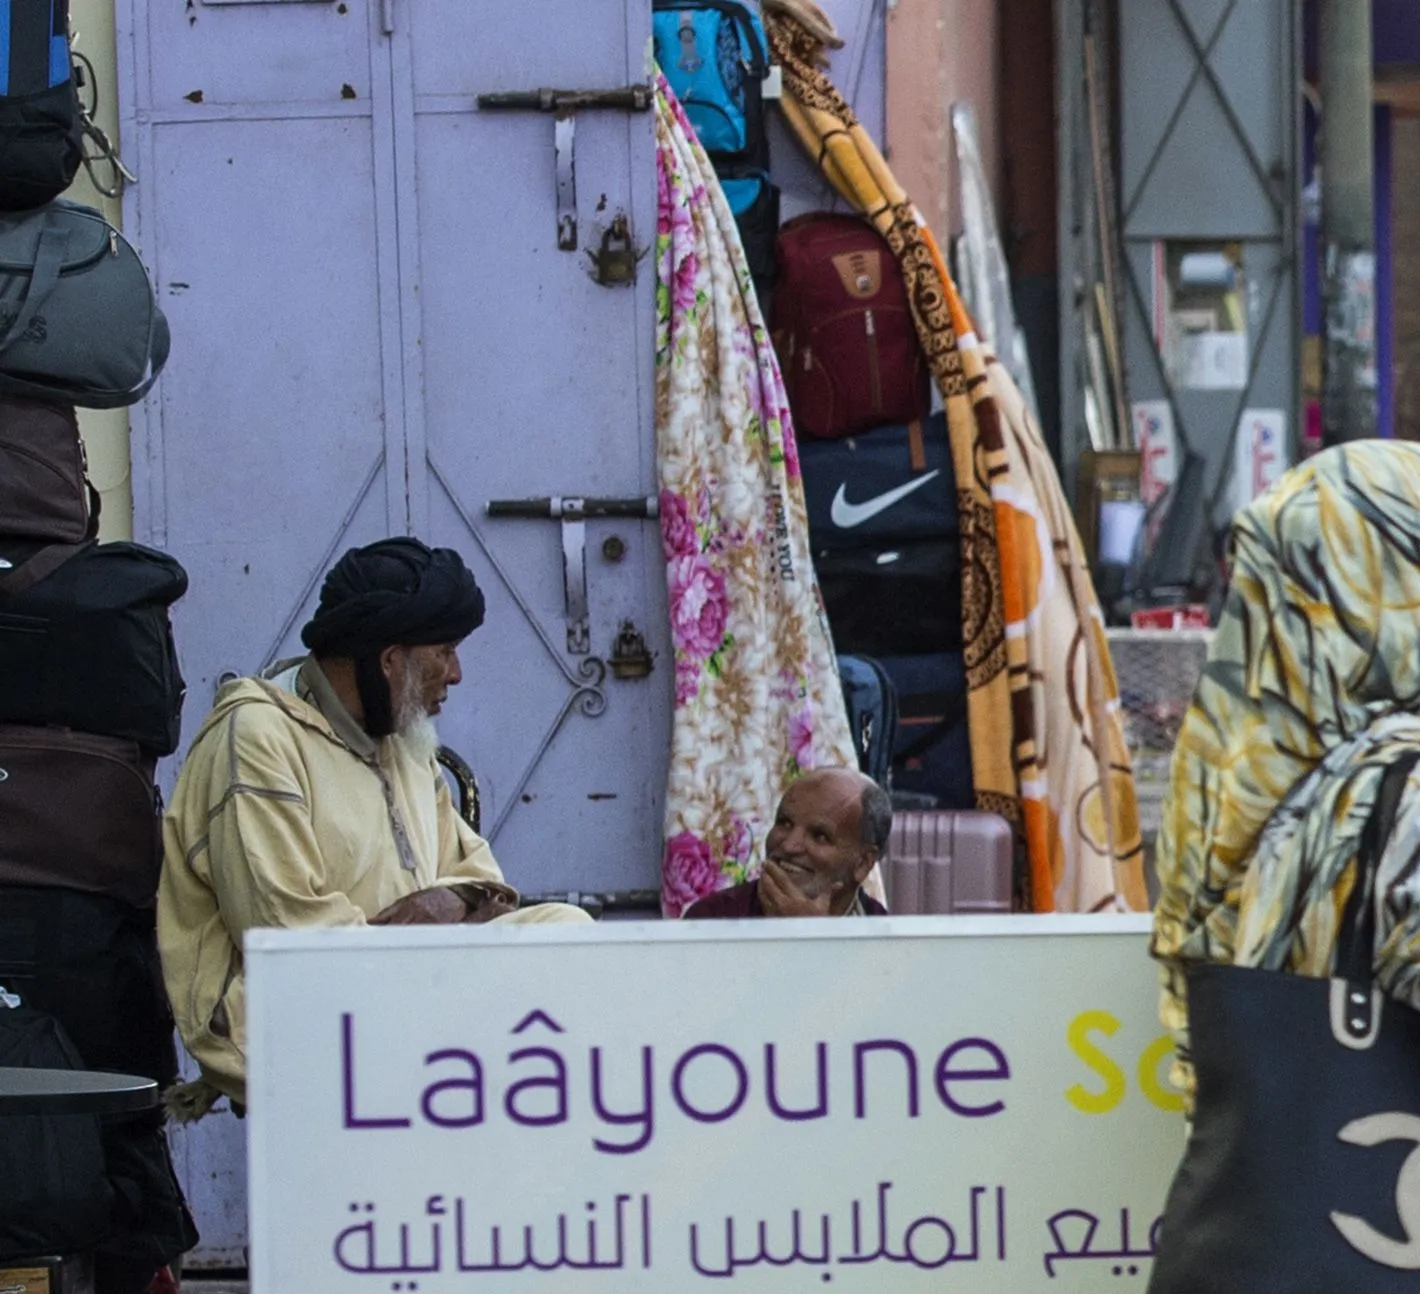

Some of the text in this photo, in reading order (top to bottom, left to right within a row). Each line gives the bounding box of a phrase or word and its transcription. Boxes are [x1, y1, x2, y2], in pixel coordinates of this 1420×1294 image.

[777, 543, 795, 582] YOU
[340, 1008, 1012, 1156] Laâyoune
[332, 1180, 1164, 1292] يع الملابس النسائية
